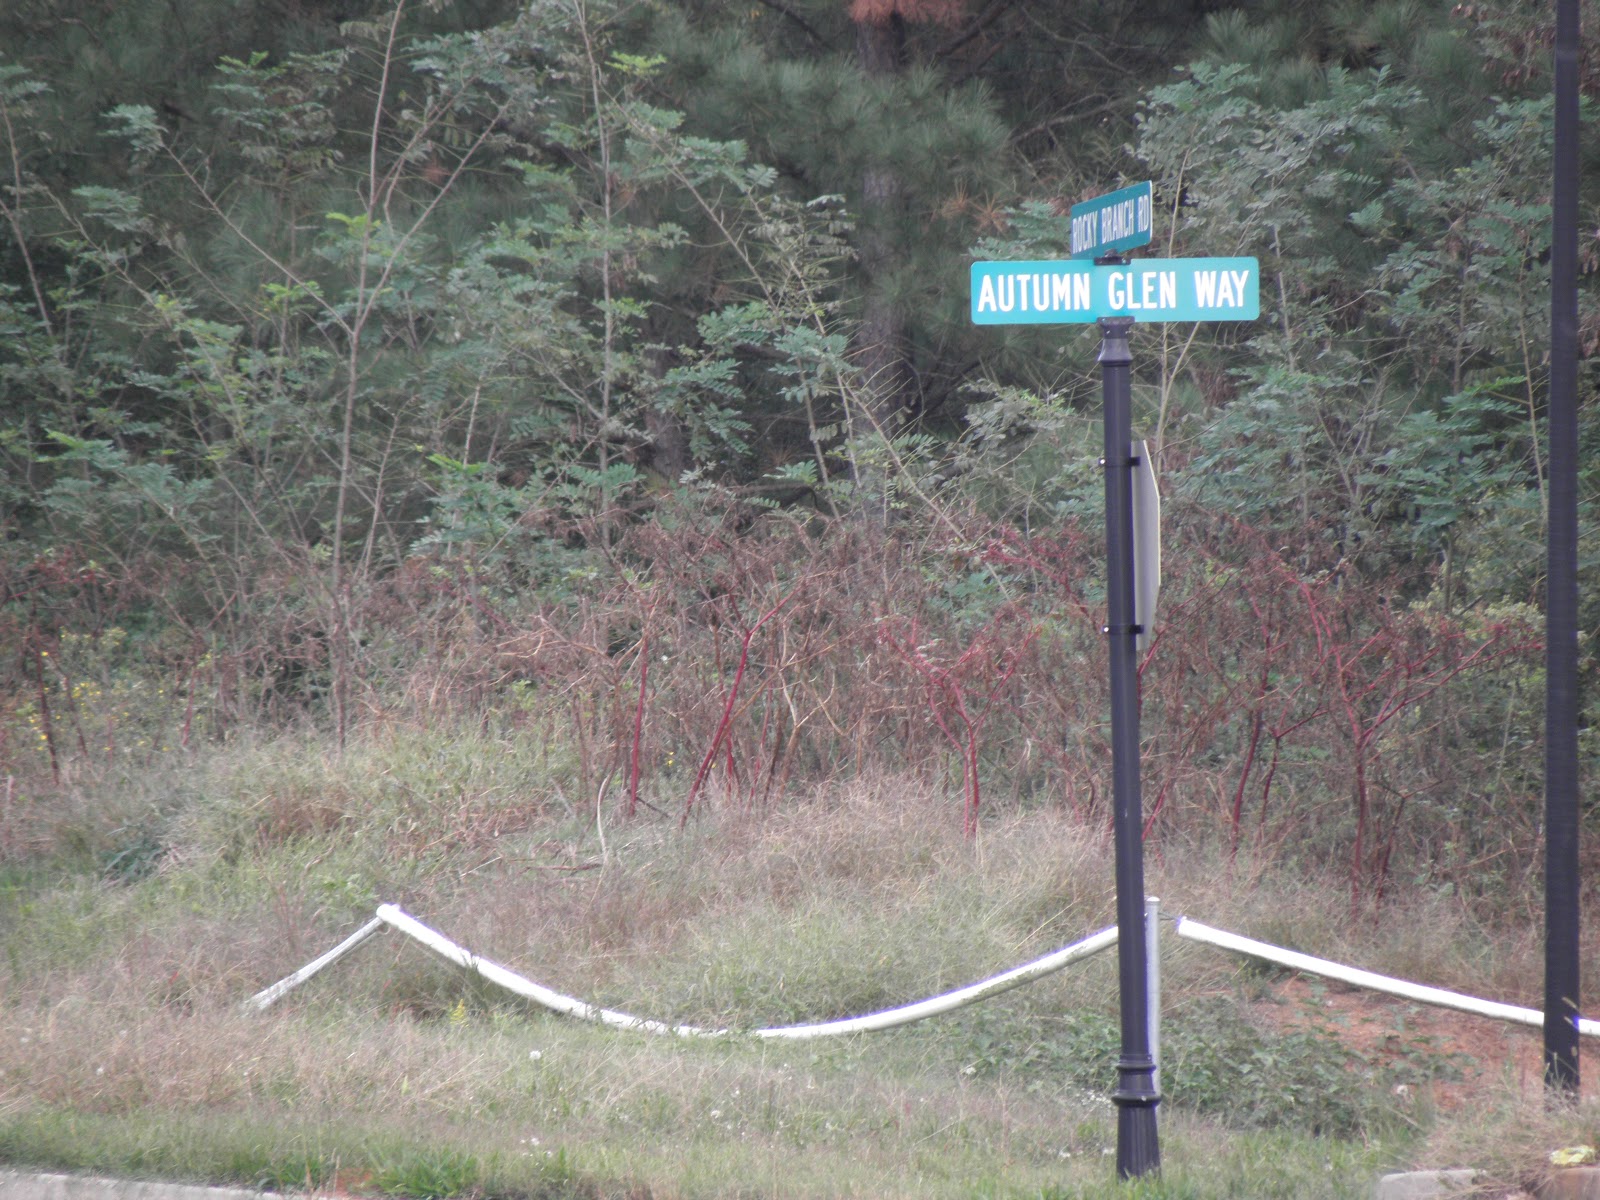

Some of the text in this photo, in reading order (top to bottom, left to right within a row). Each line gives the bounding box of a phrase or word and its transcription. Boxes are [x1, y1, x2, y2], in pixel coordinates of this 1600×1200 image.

[1073, 195, 1149, 254] ROCKY BRANCH RD
[978, 270, 1249, 312] AUTUMN GLEN WAY
